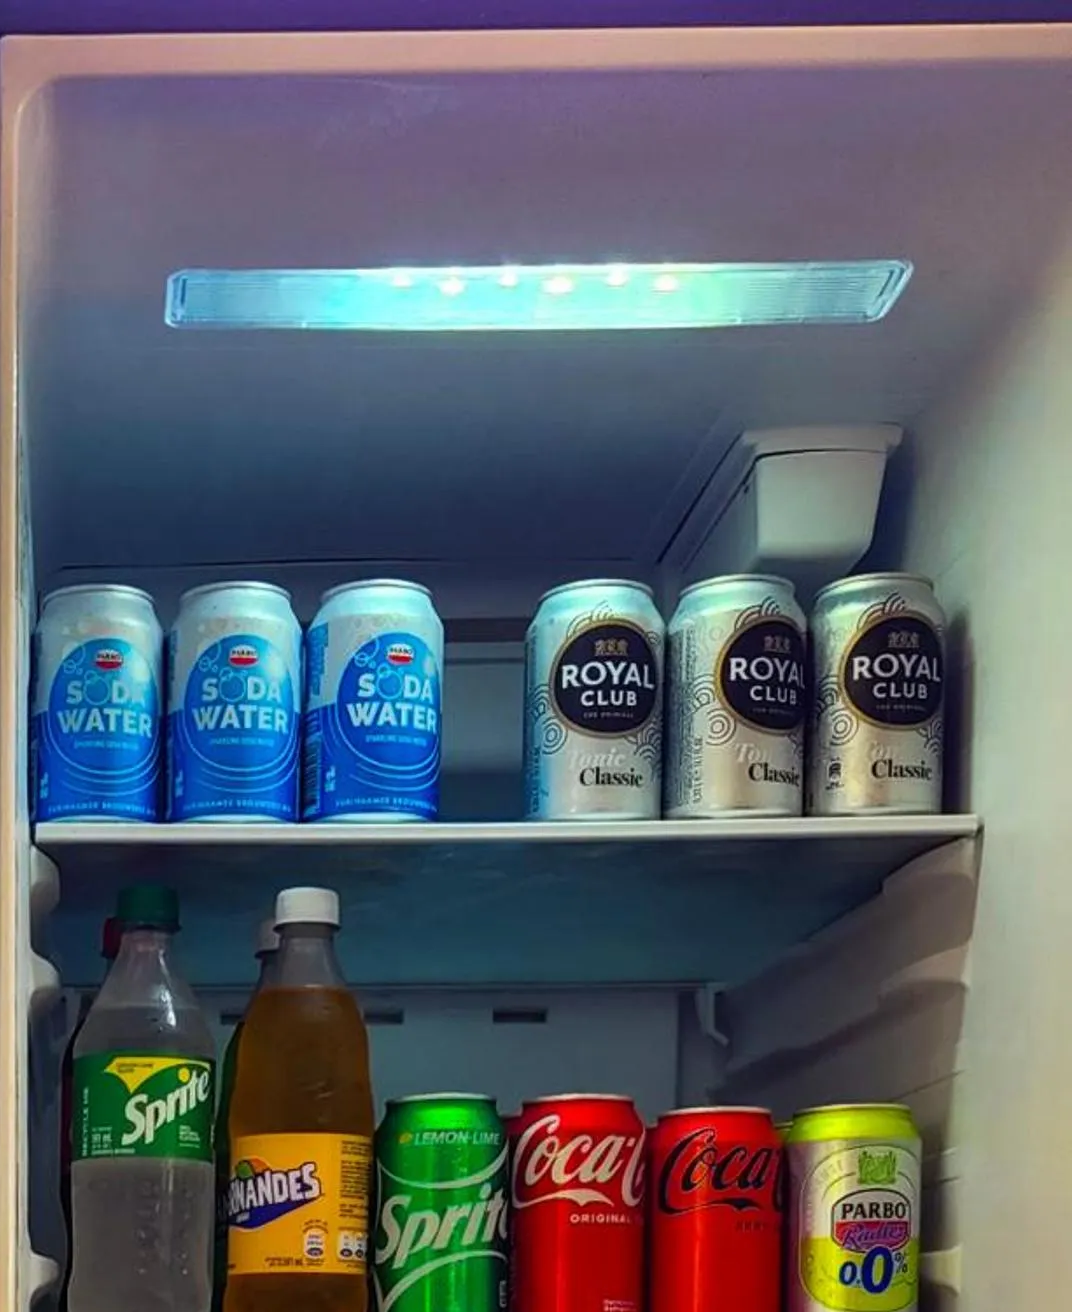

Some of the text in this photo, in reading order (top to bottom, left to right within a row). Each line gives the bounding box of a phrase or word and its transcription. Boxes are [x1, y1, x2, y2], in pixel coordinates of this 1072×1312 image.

[561, 661, 654, 689] ROYAL
[729, 656, 805, 689] ROYAL
[852, 653, 941, 683] ROYAL
[202, 674, 283, 702] SODA
[357, 673, 434, 704] SODA
[581, 690, 637, 706] CLUB
[750, 686, 797, 705] CLUB
[873, 683, 928, 699] CLUB
[57, 708, 153, 738] WATER
[192, 703, 288, 734] WATER
[346, 701, 438, 734] WATER
[579, 767, 644, 787] Classic
[748, 762, 801, 787] Classic
[871, 758, 932, 781] Classic
[121, 1069, 210, 1145] Sprite
[415, 1131, 499, 1146] LEMON-LIME
[842, 1201, 907, 1219] PARBO
